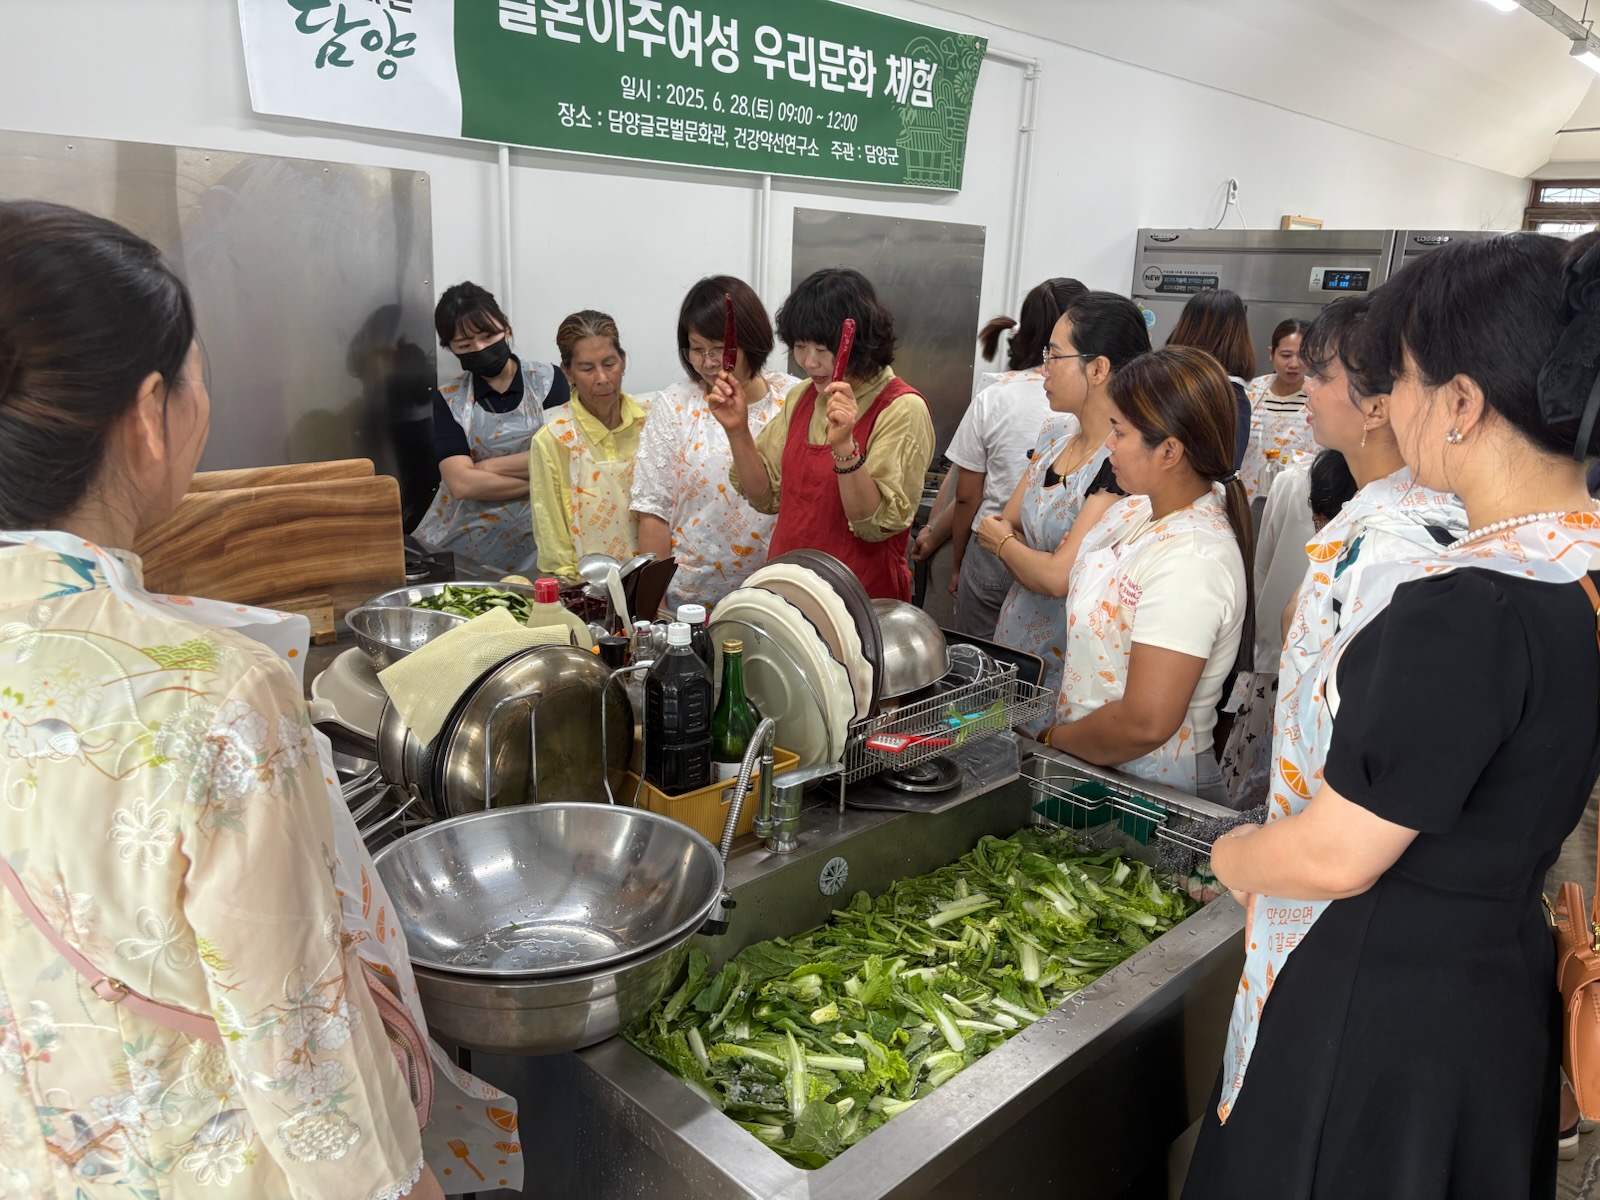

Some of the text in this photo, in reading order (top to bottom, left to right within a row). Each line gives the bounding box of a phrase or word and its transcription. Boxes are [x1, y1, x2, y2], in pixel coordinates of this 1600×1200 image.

[752, 25, 878, 98] 우리문화
[884, 53, 939, 108] 체험
[620, 75, 652, 102] 일시
[665, 83, 708, 110] 2025.
[712, 91, 726, 113] 6.
[730, 94, 774, 121] 28.(토)
[778, 102, 814, 125] 09:00
[827, 110, 858, 132] 12:00
[557, 102, 593, 128] 장소
[608, 109, 729, 148] 담양글로벌문화관,
[733, 127, 820, 157] 건강약선연구소
[831, 140, 855, 161] 주관
[864, 144, 900, 165] 담양군
[1145, 274, 1161, 282] NEW
[1266, 906, 1313, 926] 맛있으면
